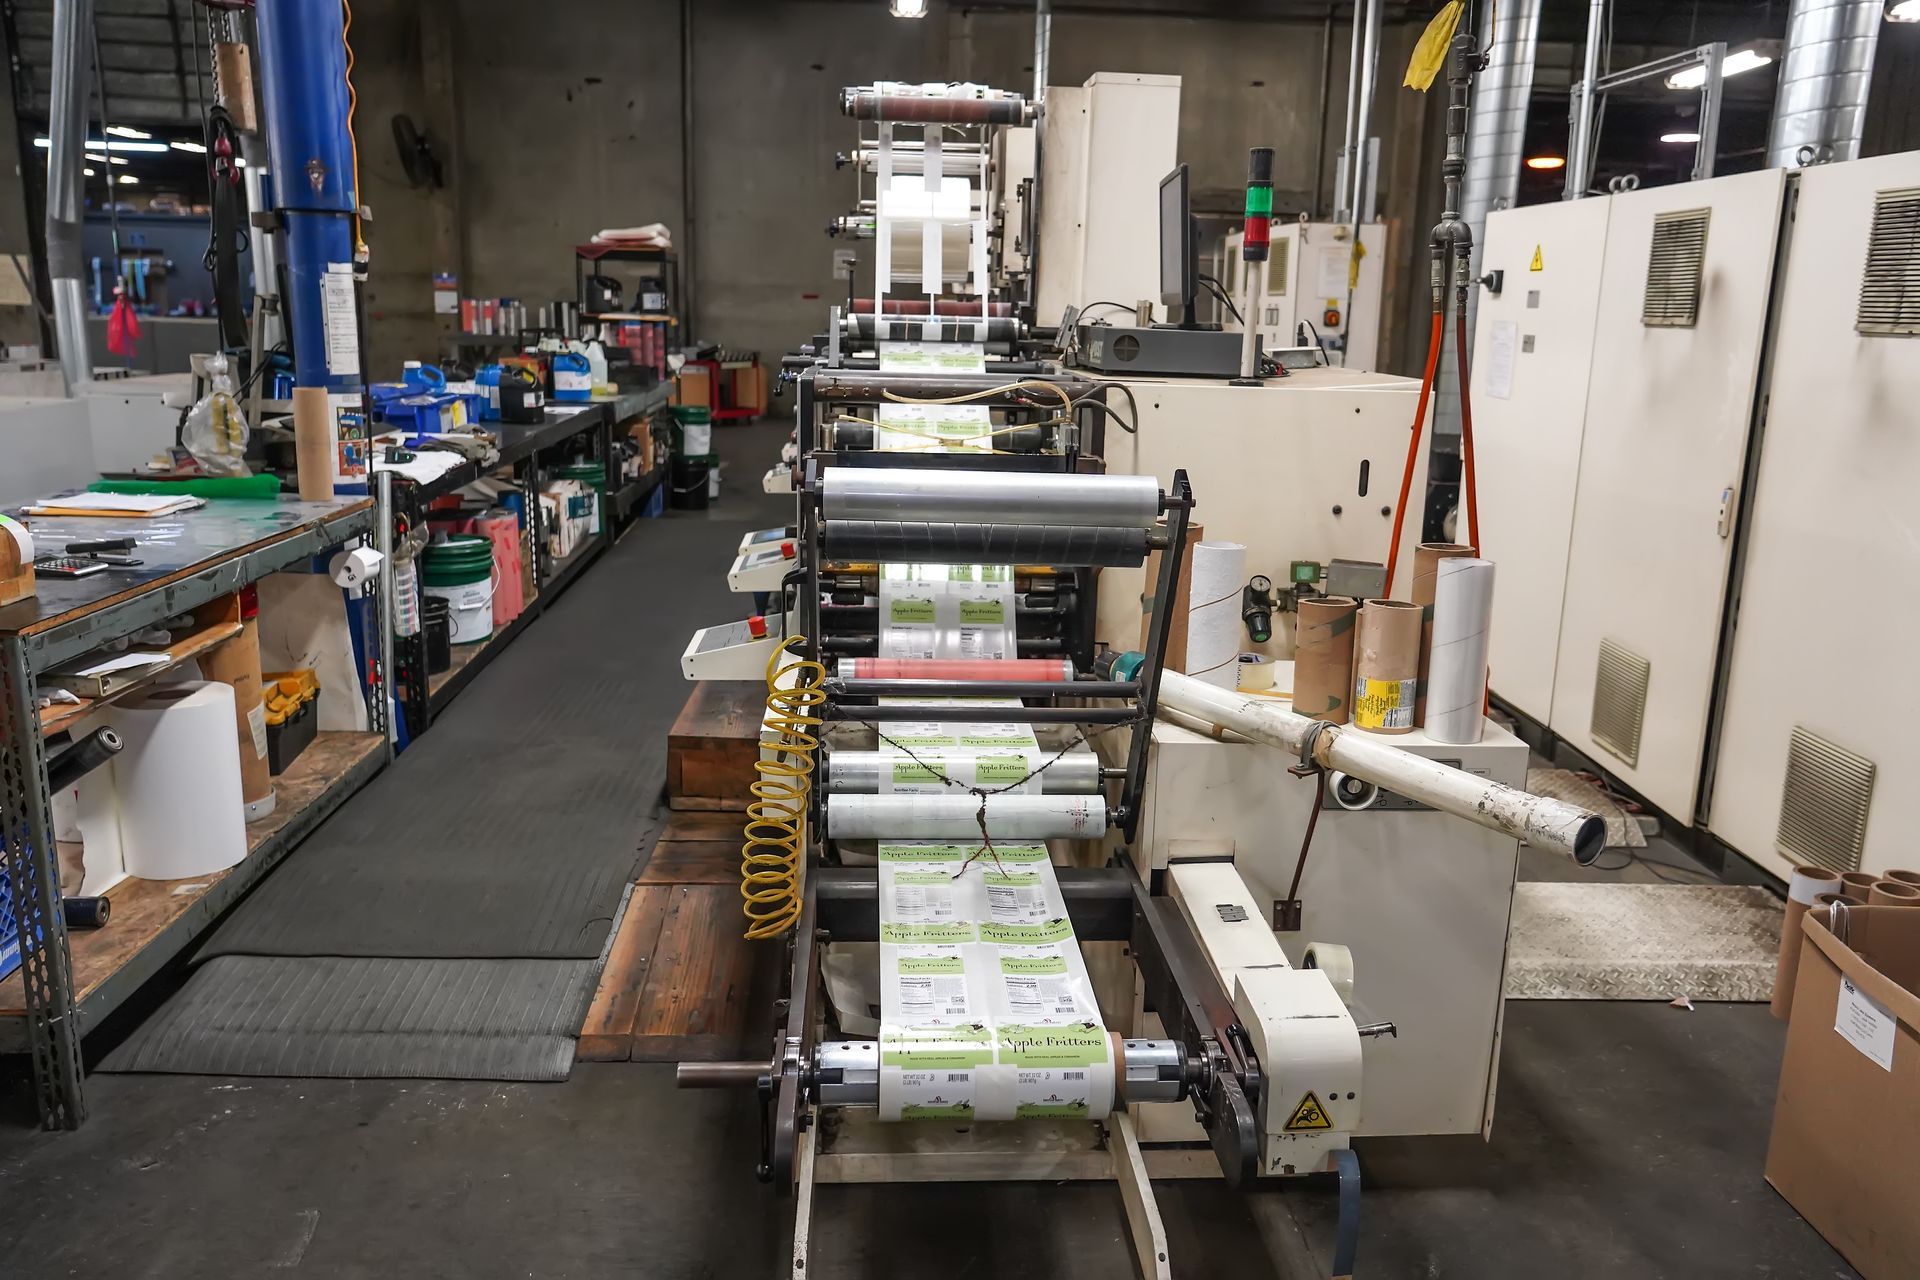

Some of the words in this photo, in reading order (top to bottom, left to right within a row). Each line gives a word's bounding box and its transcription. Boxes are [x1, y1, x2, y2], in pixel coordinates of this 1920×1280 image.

[895, 763, 915, 773] Apple
[978, 764, 998, 774] Apple
[884, 930, 920, 939] Apple
[982, 929, 1018, 939] Apple
[1020, 927, 1068, 938] Fritters
[1000, 1037, 1043, 1053] Apple
[1046, 1036, 1102, 1046] Fritters
